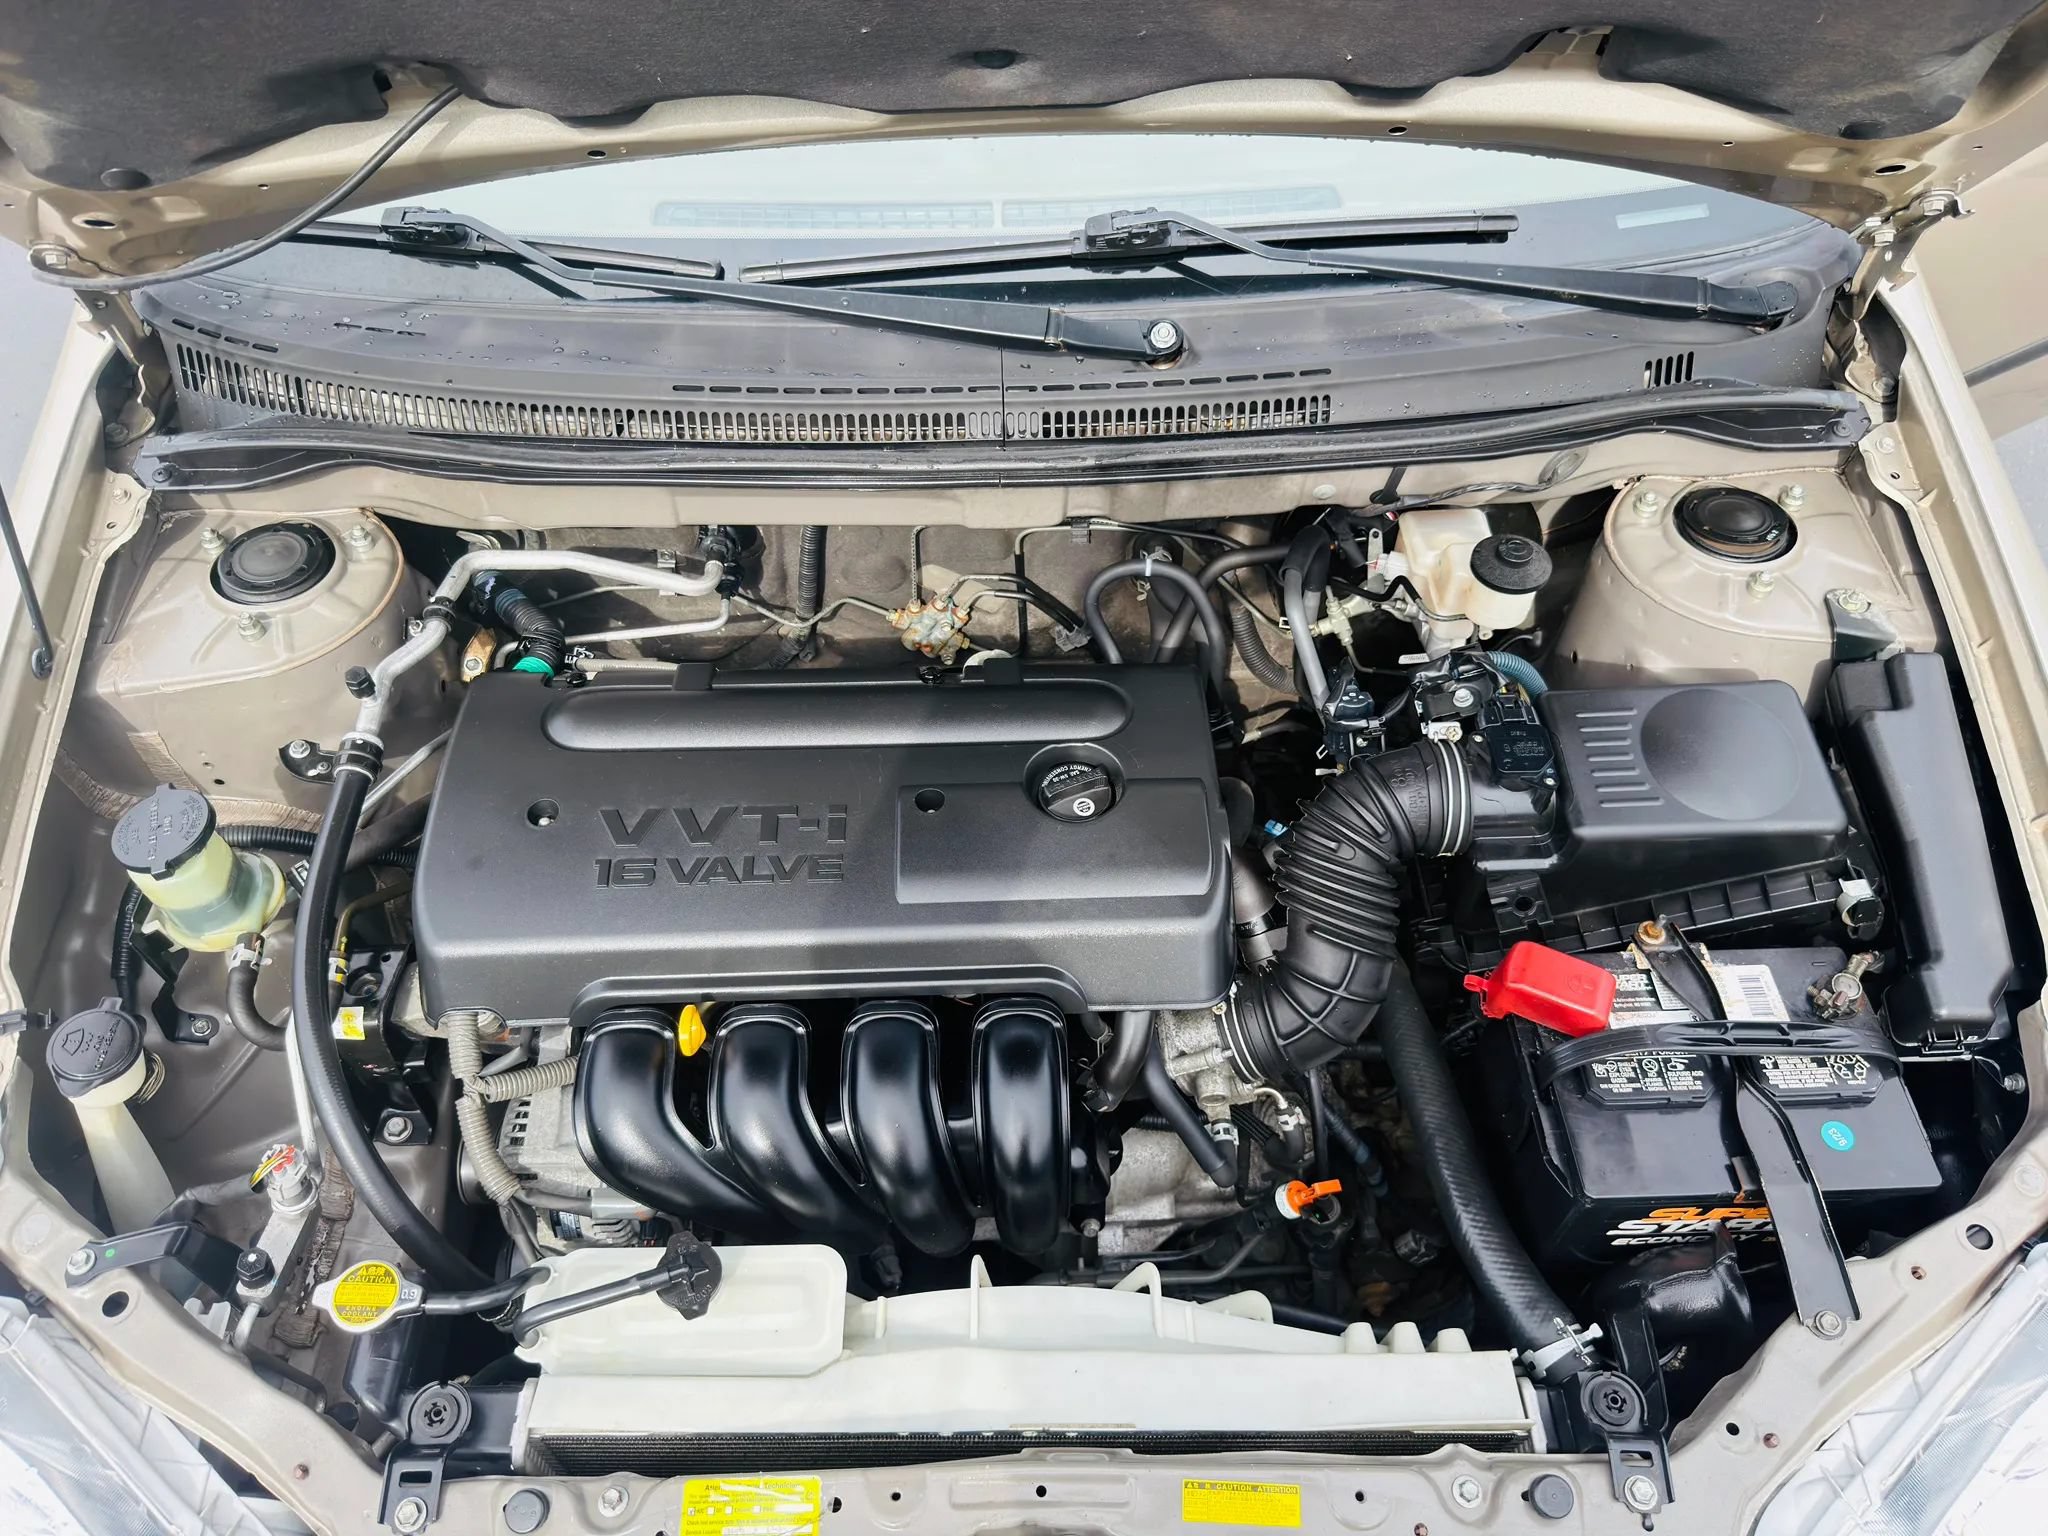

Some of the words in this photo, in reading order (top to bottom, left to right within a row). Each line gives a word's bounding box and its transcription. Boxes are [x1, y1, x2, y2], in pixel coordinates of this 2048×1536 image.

[599, 804, 848, 848] VVT-i
[592, 856, 658, 890] 16
[665, 853, 845, 886] VALVE
[1640, 1206, 1771, 1222] SUPE
[1610, 1234, 1758, 1246] ECONOY
[347, 1275, 393, 1284] CAUTION
[1216, 1483, 1252, 1492] CAUTION
[1257, 1486, 1297, 1494] ATTENTION
